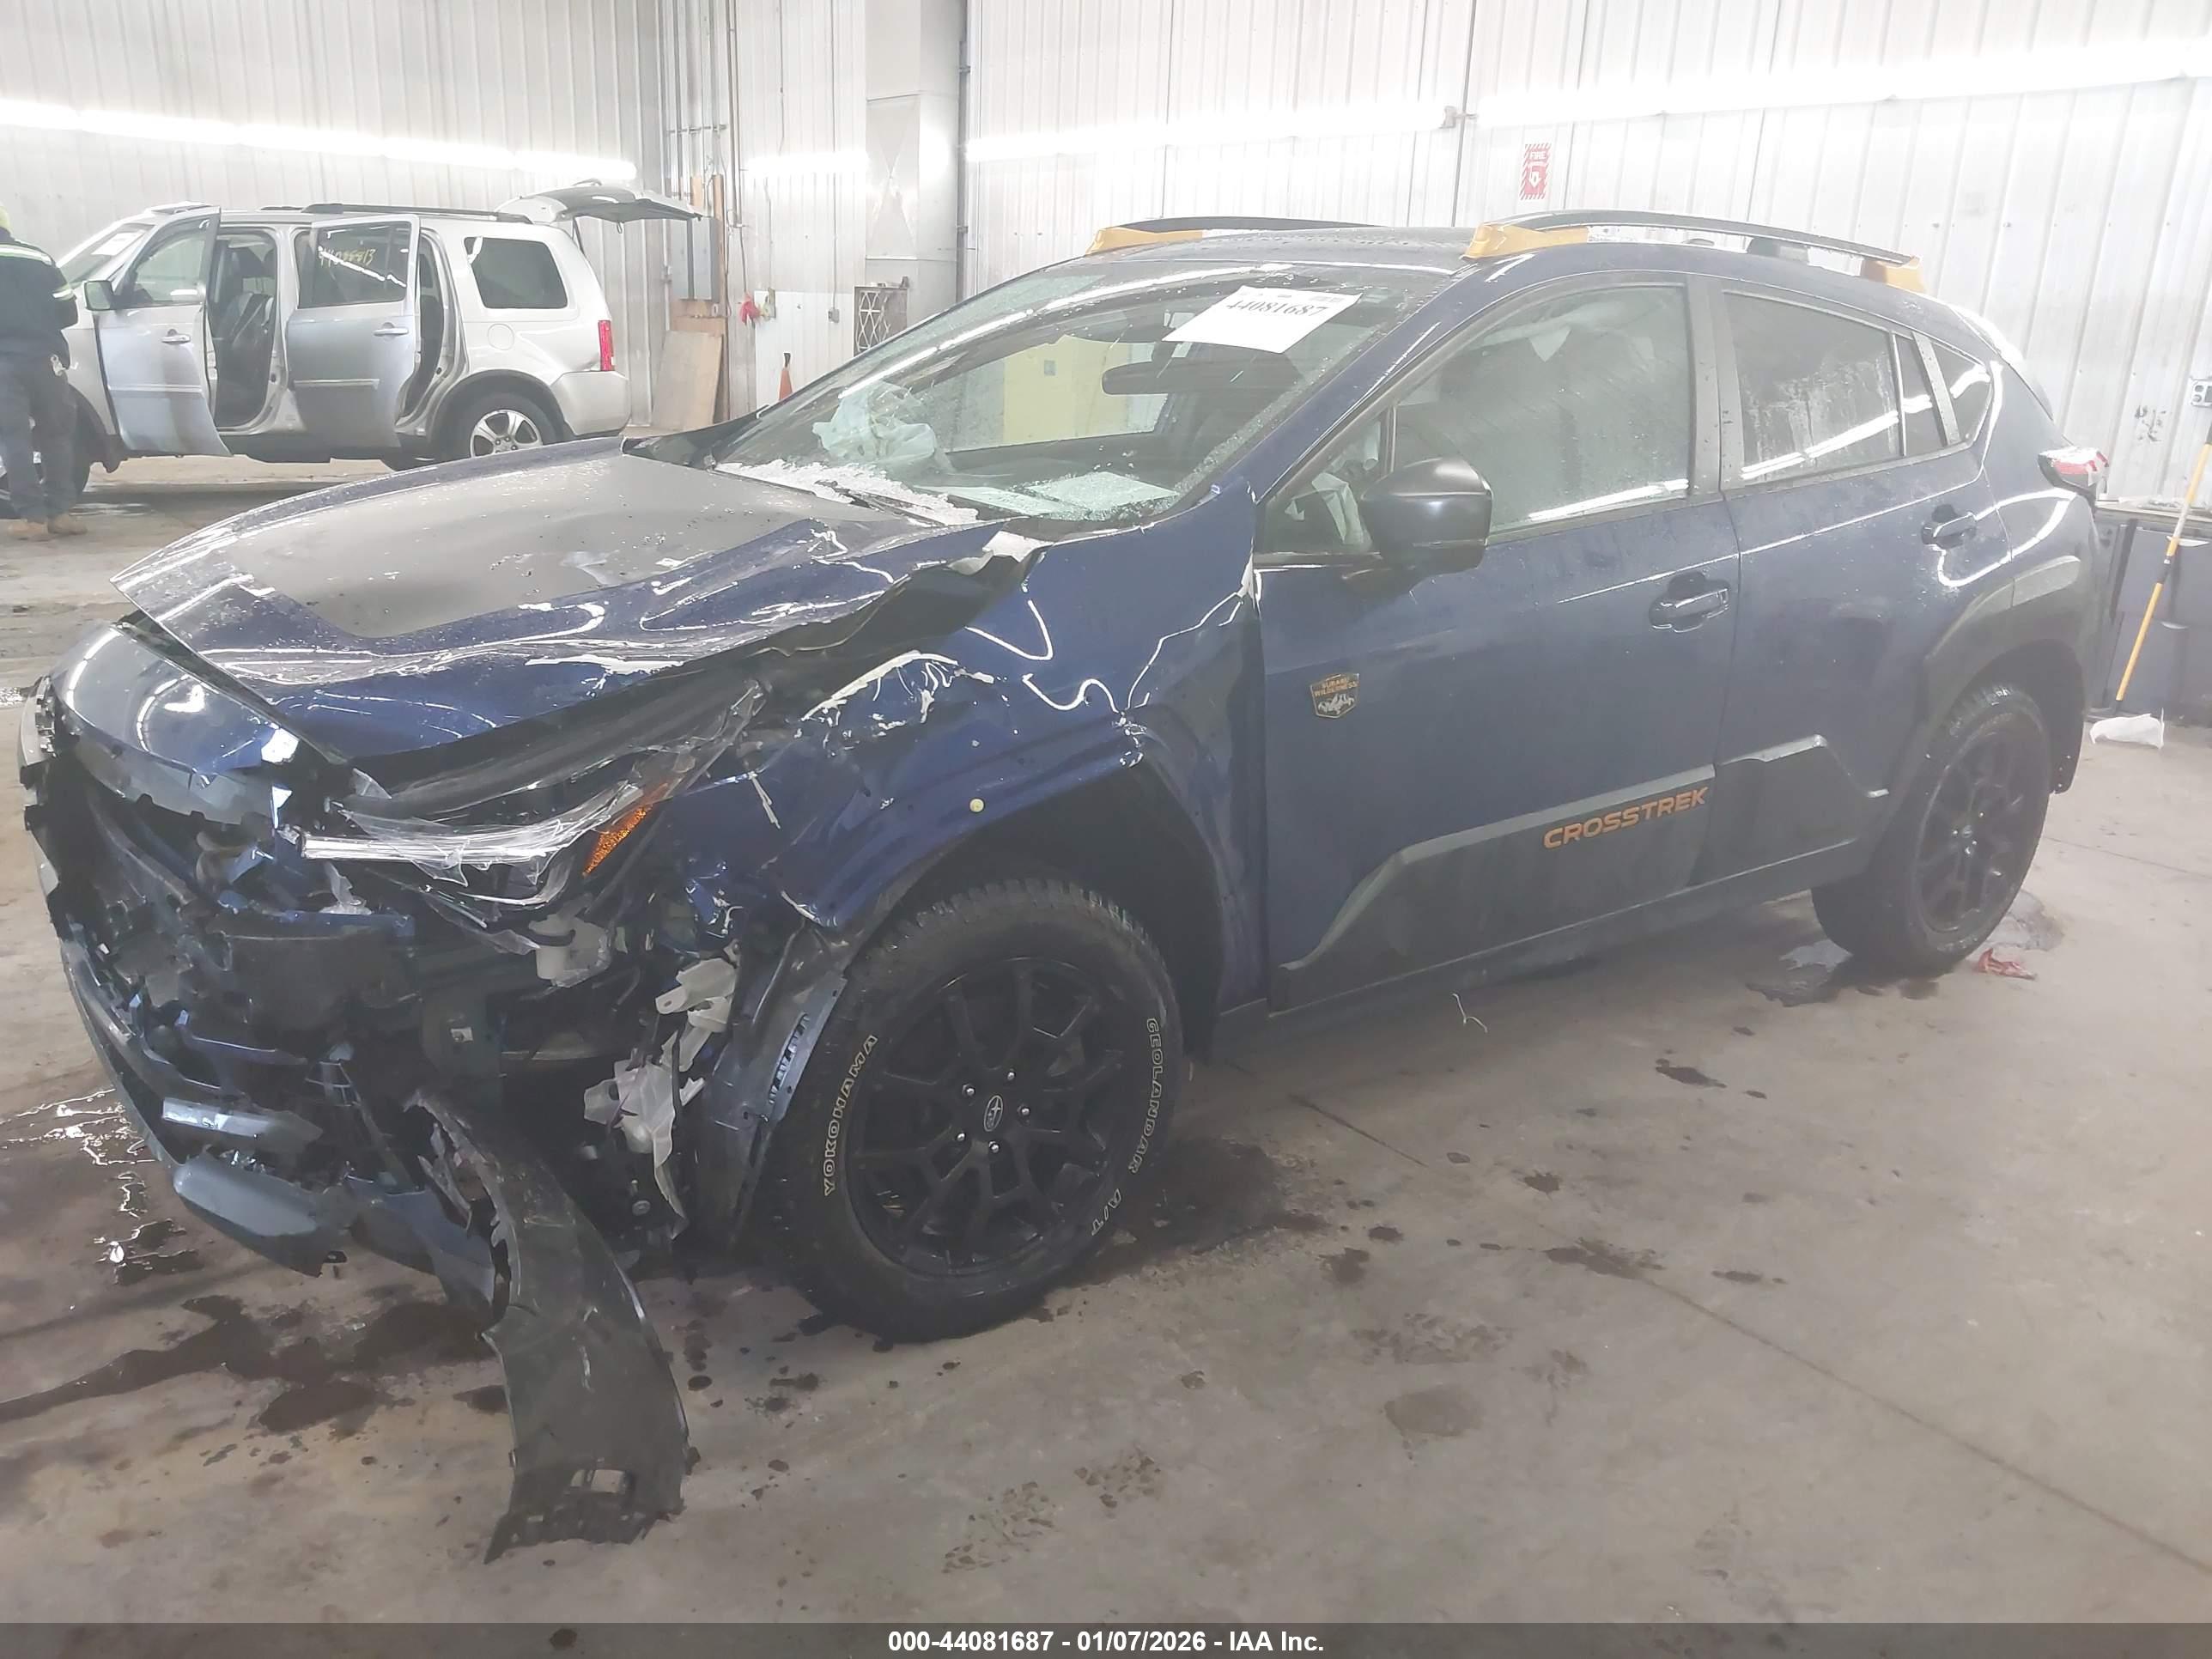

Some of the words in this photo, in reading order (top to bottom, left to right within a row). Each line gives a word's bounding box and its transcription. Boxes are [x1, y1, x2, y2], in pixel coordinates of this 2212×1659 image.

[1226, 299, 1331, 317] 44081687
[1543, 786, 1709, 848] CROSSTREK
[823, 1035, 878, 1197] YOKOHAMA
[1128, 1018, 1164, 1174] GEOLANDAR
[1091, 1188, 1122, 1236] A/T
